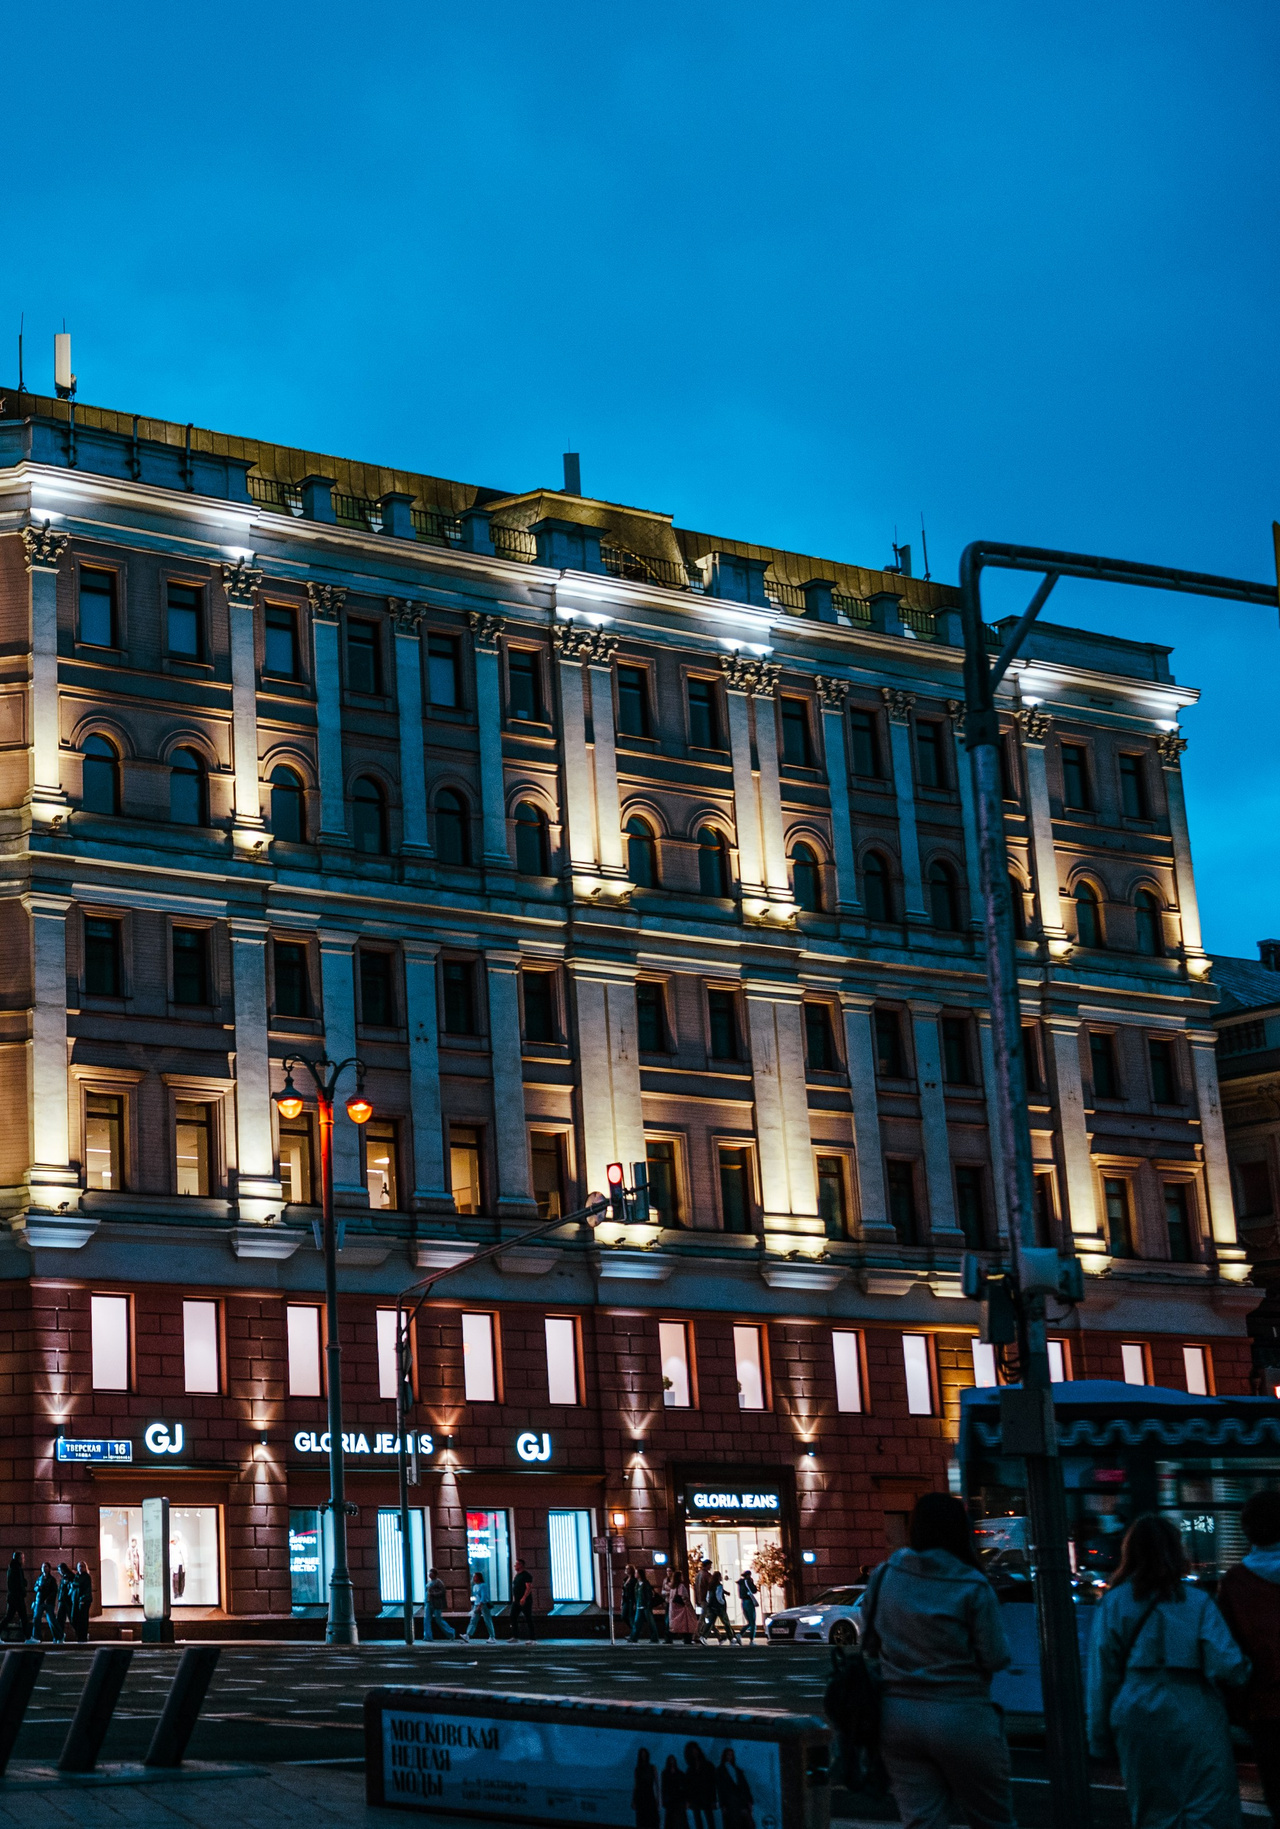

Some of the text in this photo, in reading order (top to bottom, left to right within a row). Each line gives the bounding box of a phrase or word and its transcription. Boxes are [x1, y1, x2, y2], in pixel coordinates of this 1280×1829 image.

[65, 1443, 102, 1453] ТВЕРСКАЯ
[113, 1443, 126, 1455] 16
[144, 1423, 183, 1454] GJ
[516, 1432, 551, 1461] GJ
[693, 1493, 779, 1508] GLORIA JEANS
[390, 1719, 500, 1750] МОСКОВСКАЯ
[391, 1745, 451, 1772] НЕДЕЛЯ
[391, 1769, 444, 1798] МОДЫ
